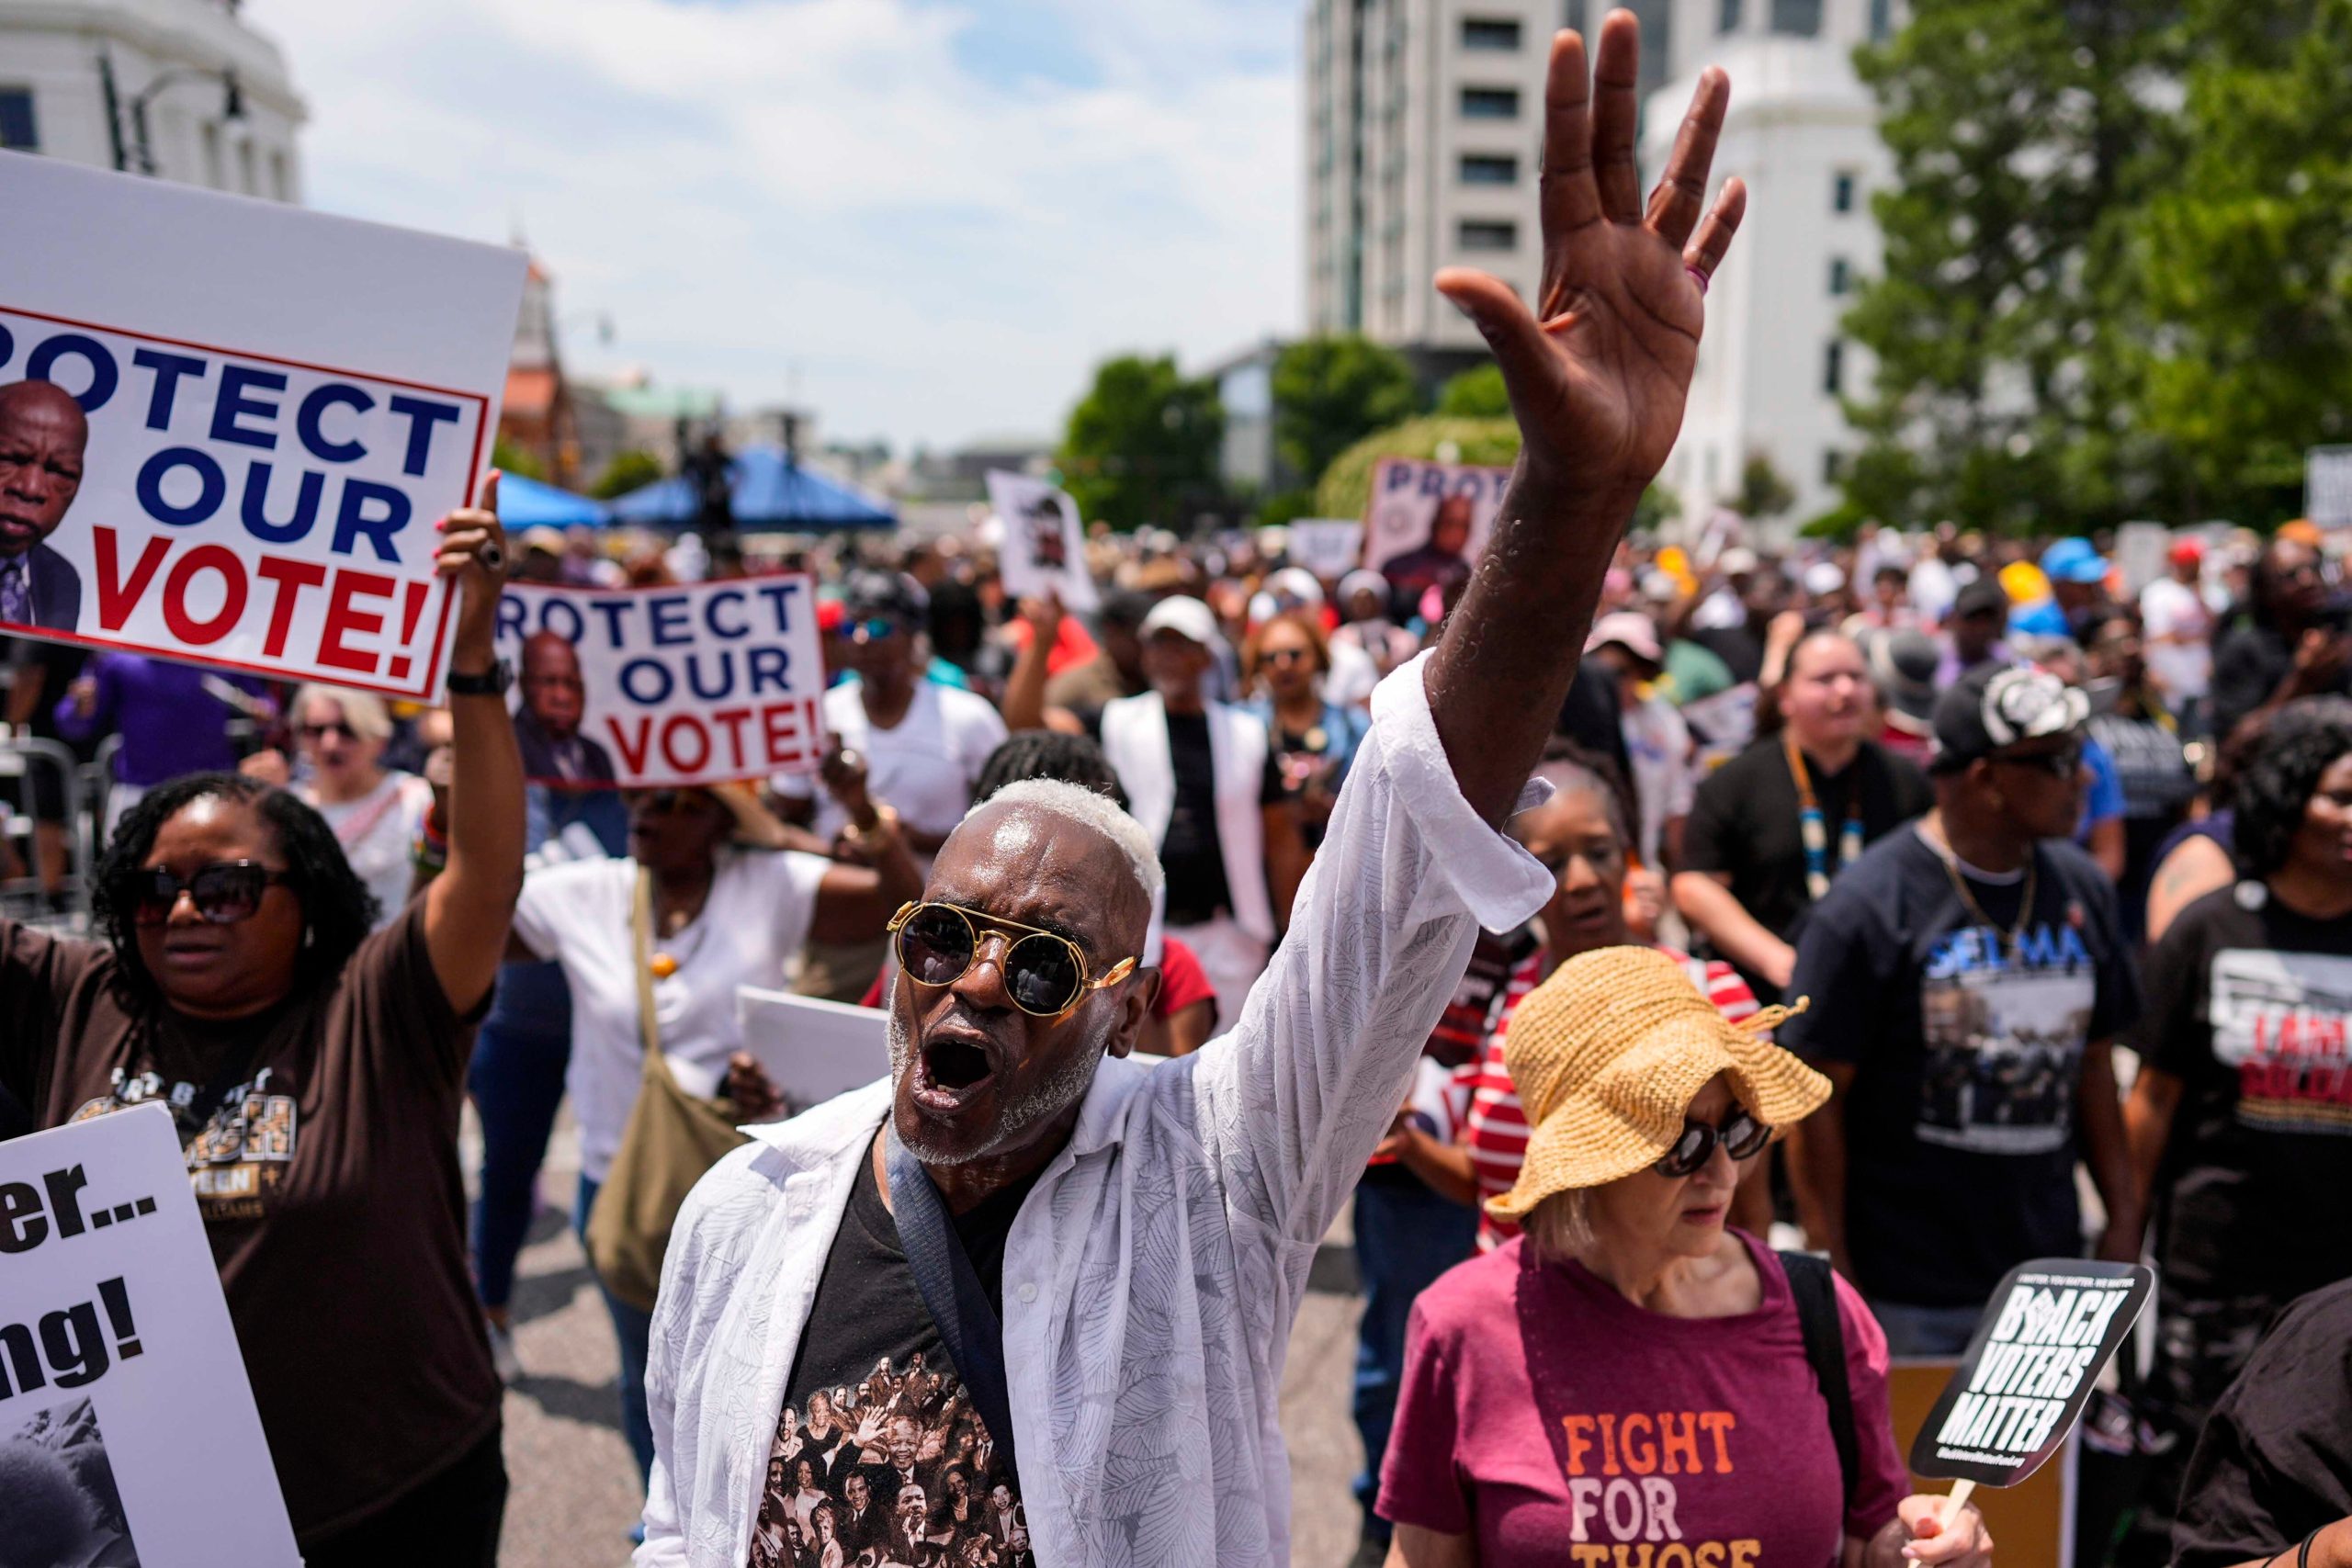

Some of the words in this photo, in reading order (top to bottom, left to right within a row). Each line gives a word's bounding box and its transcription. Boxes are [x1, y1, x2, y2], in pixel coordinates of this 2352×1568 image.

[0, 321, 460, 478] OTECT
[136, 446, 413, 564] OUR
[93, 525, 430, 680] VOTE!
[618, 647, 790, 705] OUR
[605, 700, 820, 776] VOTE!
[1926, 921, 2090, 979] SELMA
[1968, 1340, 2098, 1400] VOTERS
[1563, 1411, 1736, 1475] FIGHT
[1936, 1391, 2066, 1452] MATTER
[1568, 1476, 1682, 1541] FOR
